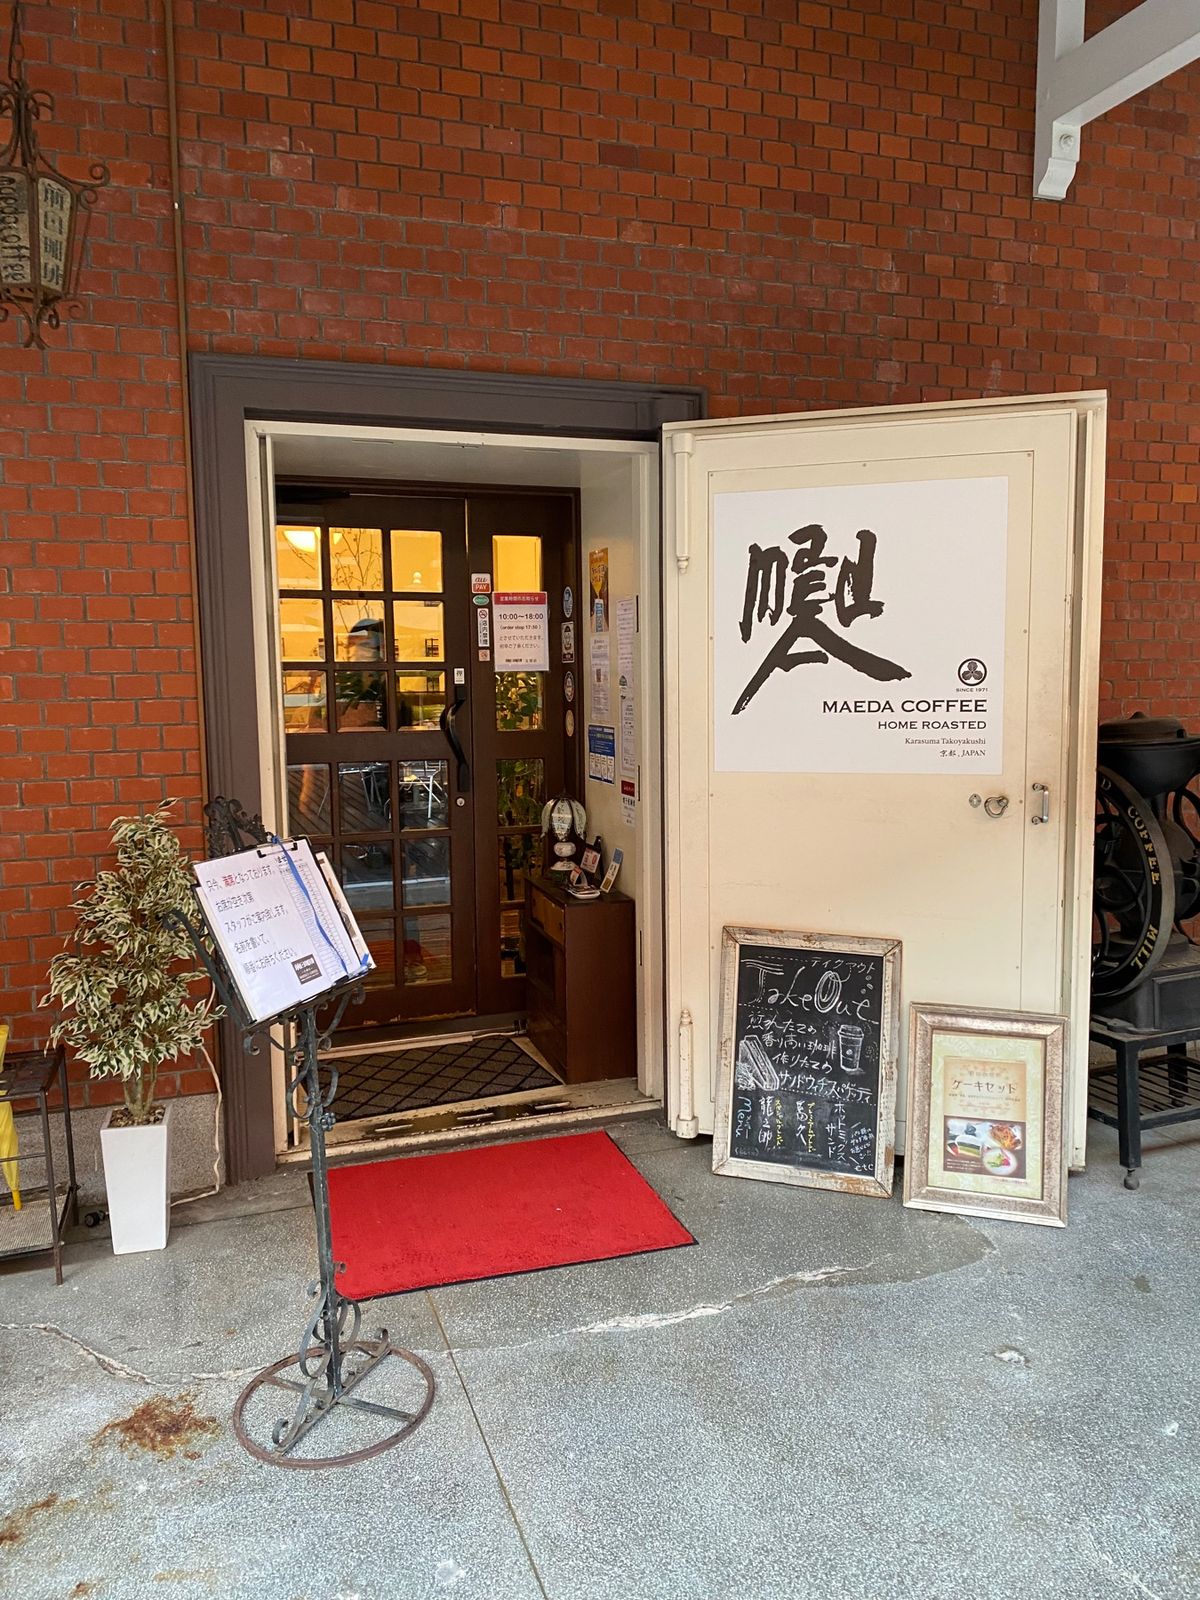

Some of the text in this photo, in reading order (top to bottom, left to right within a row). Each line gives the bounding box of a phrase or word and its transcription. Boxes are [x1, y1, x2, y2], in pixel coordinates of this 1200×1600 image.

[822, 699, 987, 714] MAEDA COFFEE
[878, 720, 987, 730] HOME ROASTED
[904, 737, 986, 746] Karasuma Takoyakushi
[961, 749, 986, 758] JAPAN
[1127, 805, 1161, 885] COFFEE
[1130, 923, 1158, 971] MILL
[762, 1033, 837, 1060] 香り高い珈琲
[772, 1052, 833, 1074] 作りたての
[952, 1079, 1018, 1094] ケーキセット
